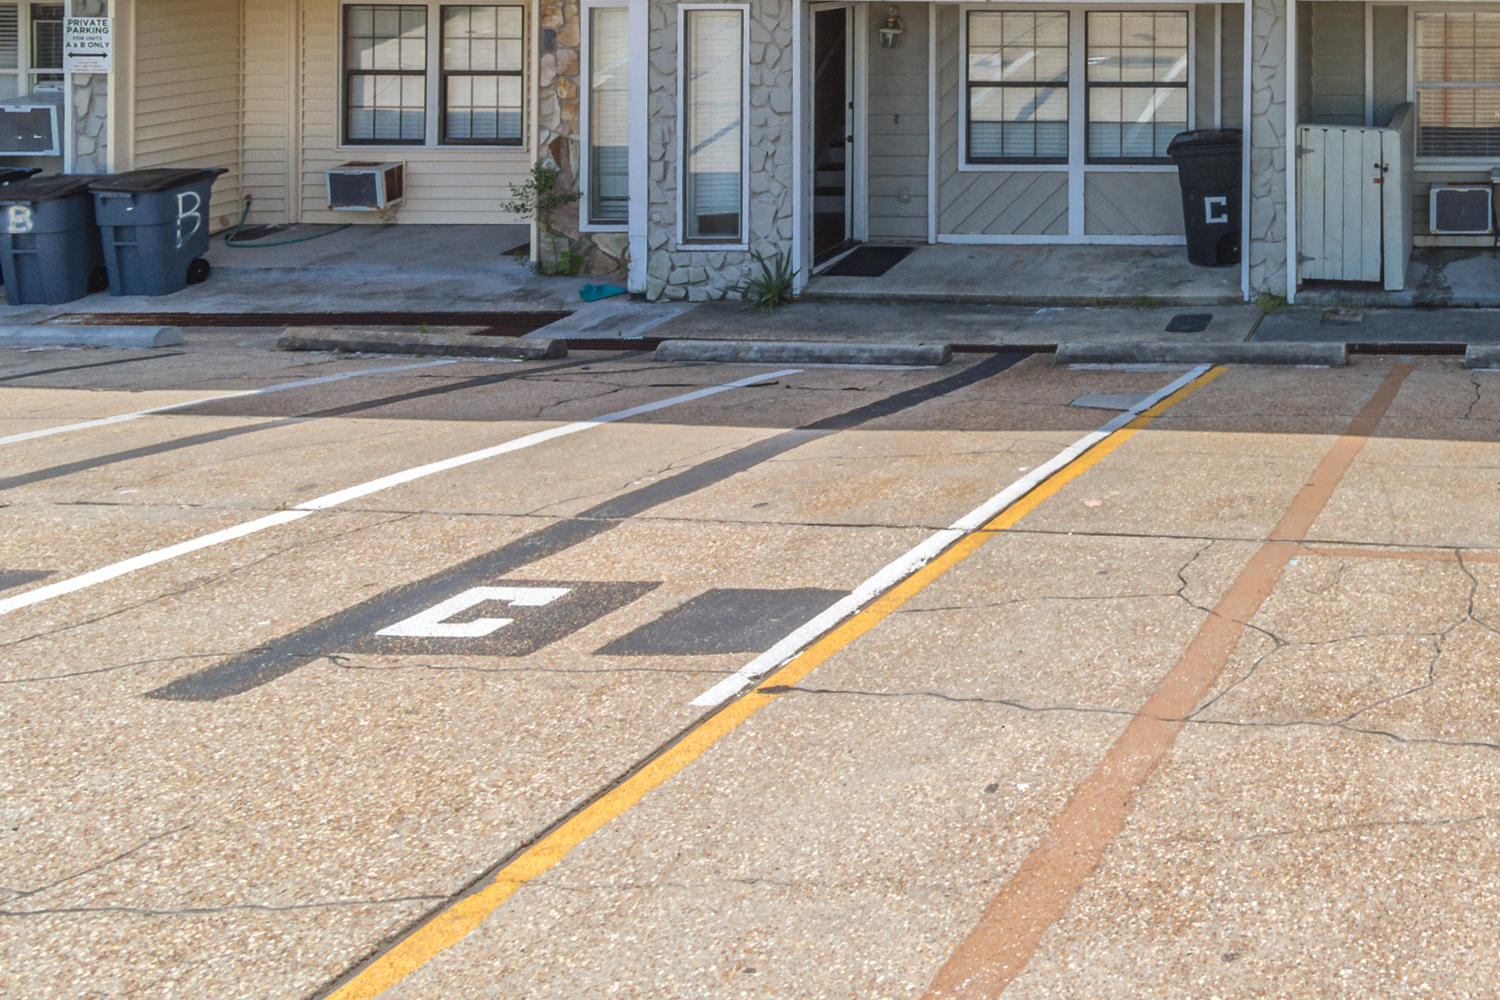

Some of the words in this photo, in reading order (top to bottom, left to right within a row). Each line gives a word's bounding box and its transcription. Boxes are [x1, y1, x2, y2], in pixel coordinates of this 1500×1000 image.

[8, 205, 34, 233] B
[177, 191, 201, 248] B
[1204, 196, 1228, 224] C
[373, 586, 572, 637] C
